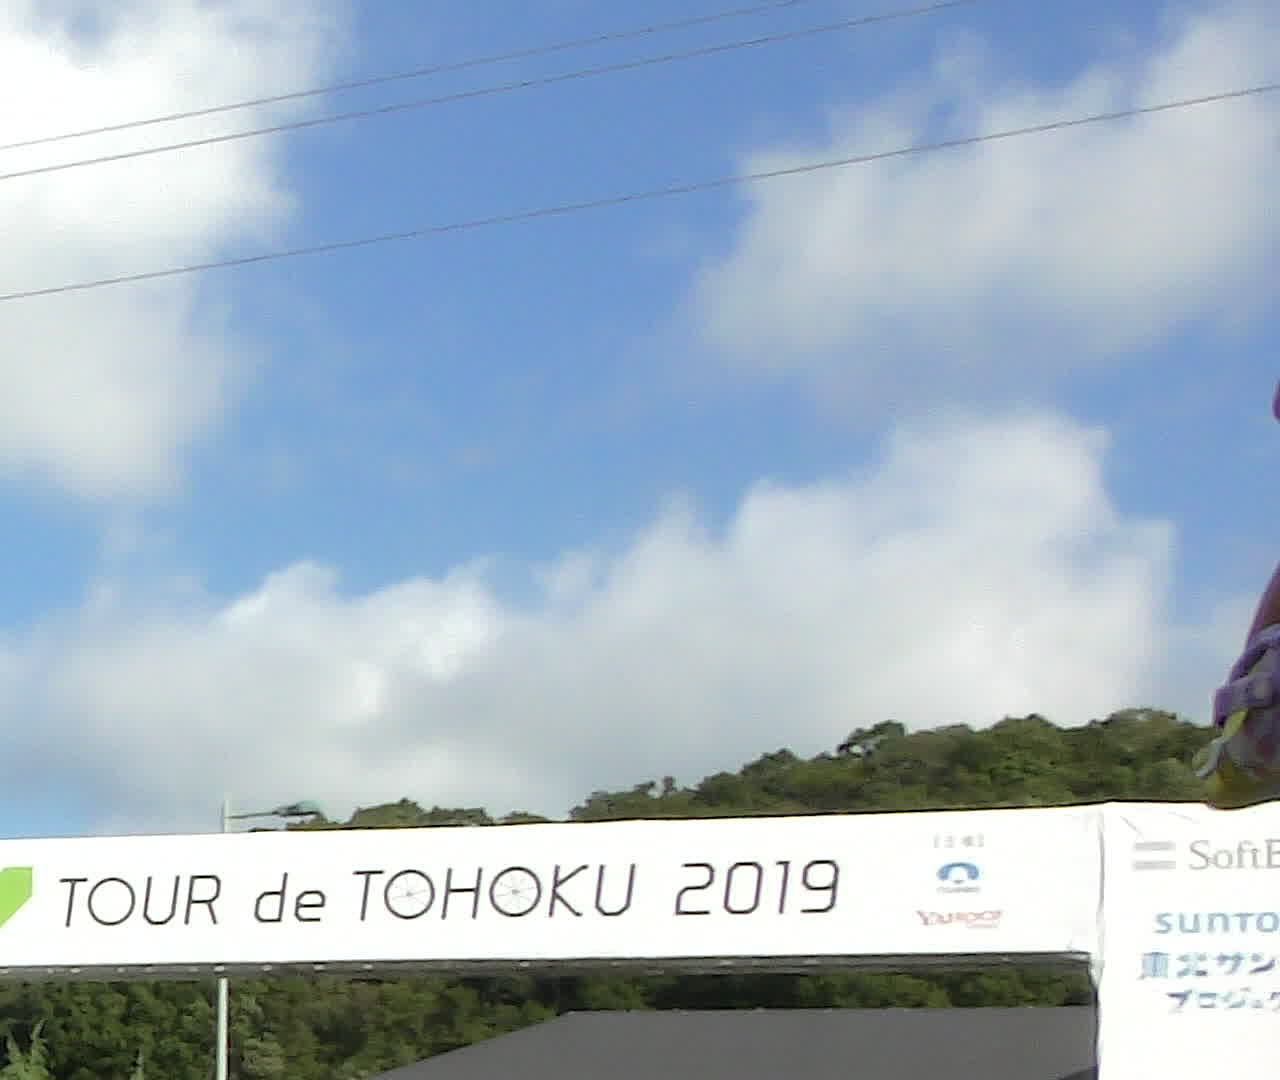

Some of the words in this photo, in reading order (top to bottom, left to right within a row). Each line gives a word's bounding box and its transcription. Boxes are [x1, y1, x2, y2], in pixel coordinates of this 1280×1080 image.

[58, 873, 223, 929] TOUR
[253, 871, 328, 924] de
[351, 862, 638, 923] TOHOKU
[674, 859, 842, 918] 2019
